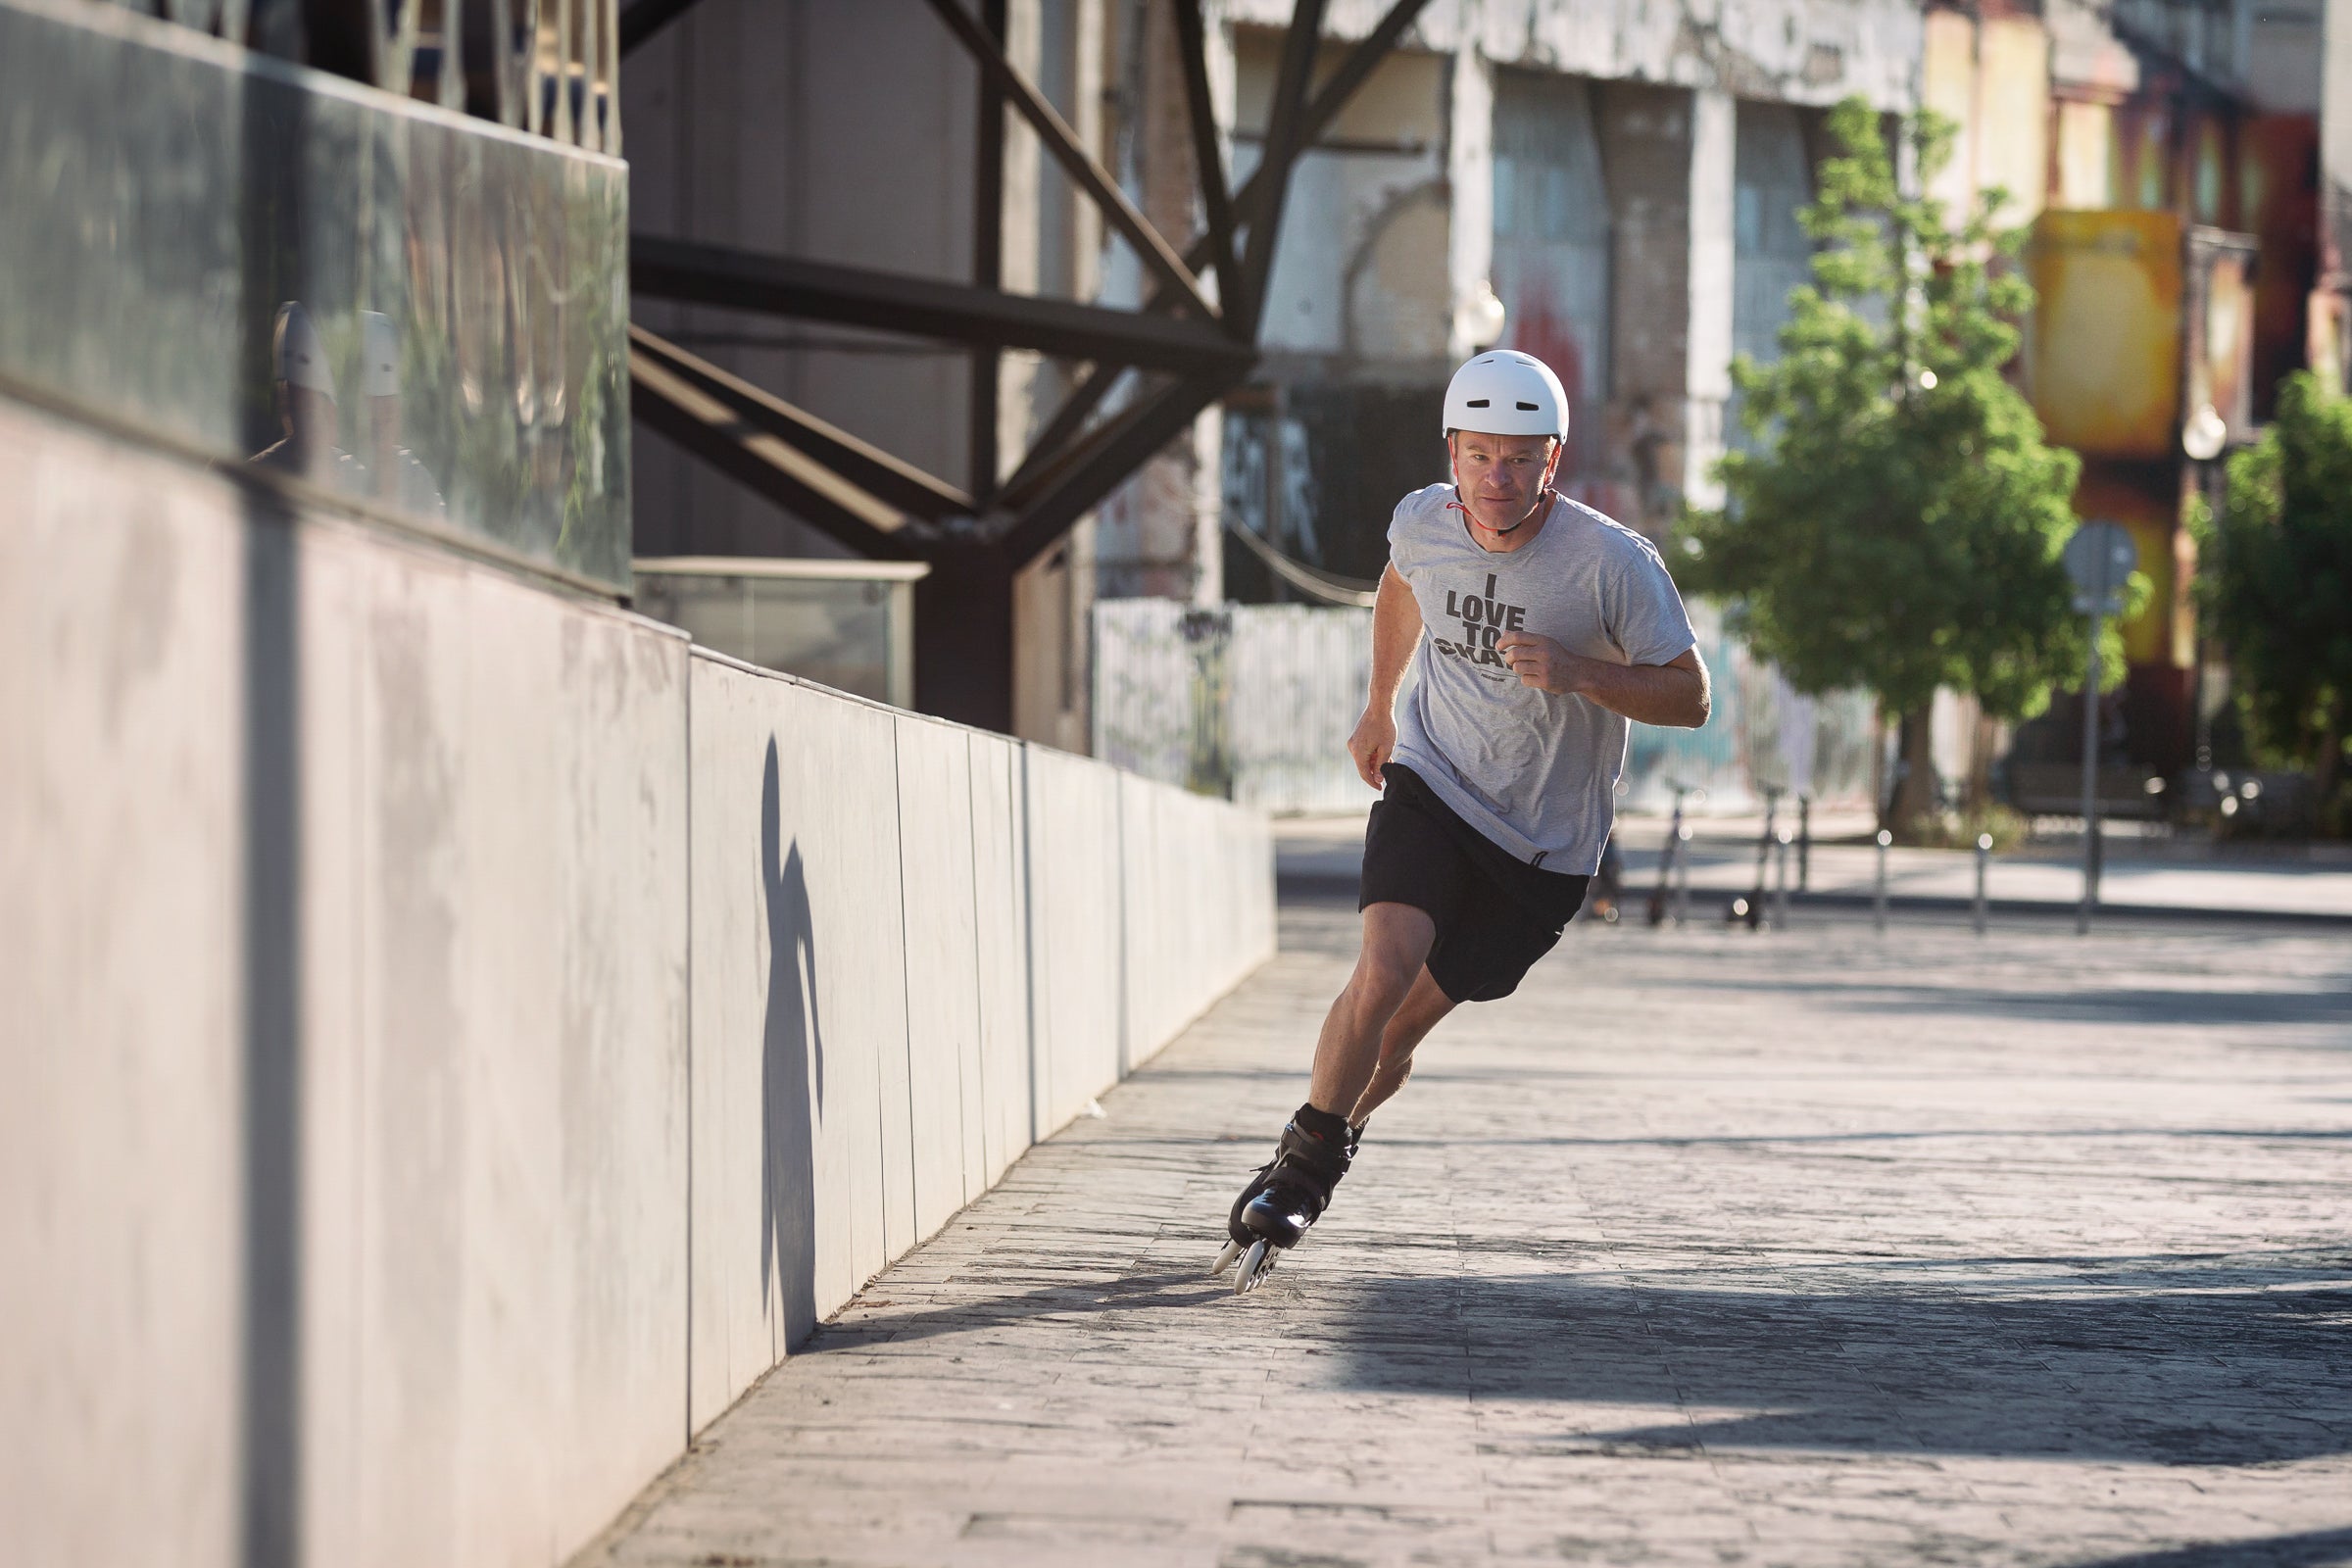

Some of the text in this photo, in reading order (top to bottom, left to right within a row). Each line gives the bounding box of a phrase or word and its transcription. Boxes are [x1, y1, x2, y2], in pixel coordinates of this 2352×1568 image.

[1485, 573, 1497, 600] I
[1446, 590, 1526, 632] LOVE
[1462, 620, 1502, 650] TO
[1434, 637, 1514, 671] SKA
